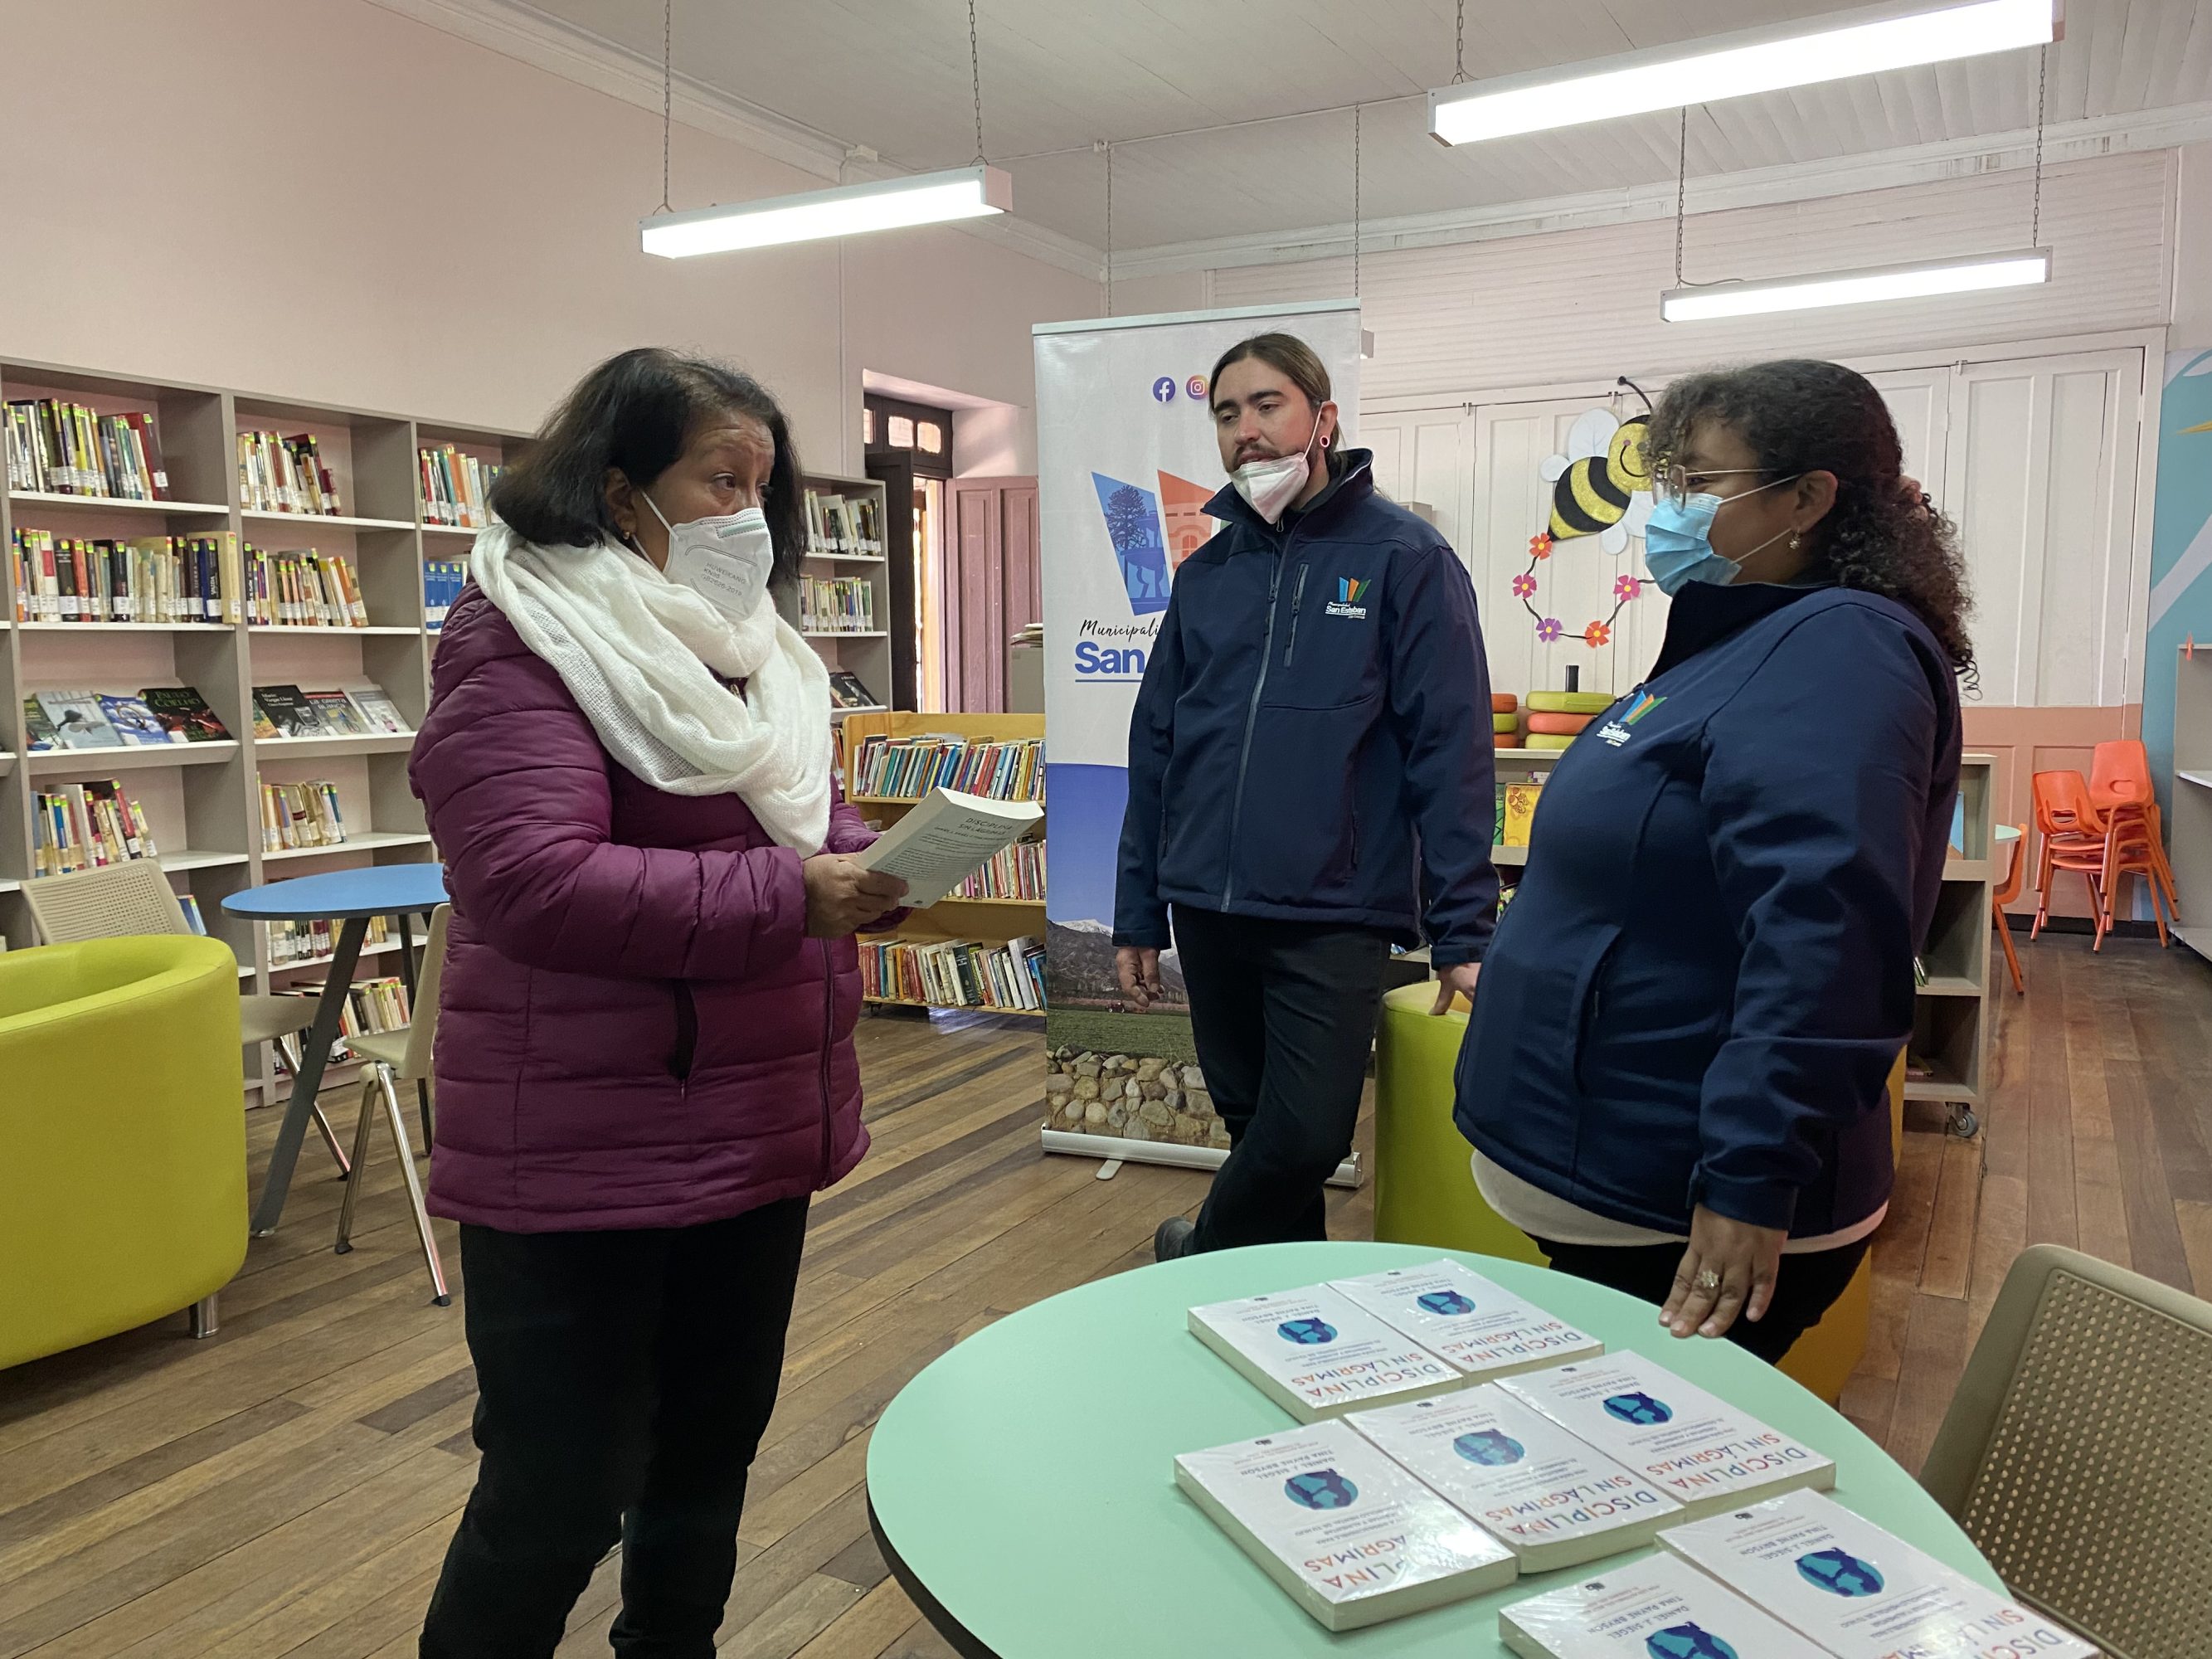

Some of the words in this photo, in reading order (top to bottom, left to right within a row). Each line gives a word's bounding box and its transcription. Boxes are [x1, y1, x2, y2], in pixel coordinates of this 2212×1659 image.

[1079, 618, 1159, 643] Municipali
[1075, 641, 1145, 674] San
[1459, 1331, 1583, 1364] DISCIPLINA
[1392, 1353, 1424, 1367] SIN
[1291, 1359, 1391, 1387] LÁGRIMAS
[1305, 1363, 1441, 1398] DISCIPLINA
[1746, 1433, 1782, 1450] SIN
[1646, 1440, 1747, 1477] LÁGRIMAS
[1668, 1447, 1807, 1490] DISCIPLINA
[1593, 1476, 1633, 1493] SIN
[1485, 1484, 1595, 1522] LÁGRIMAS
[1507, 1491, 1659, 1535] DISCIPLINA
[1626, 1604, 1660, 1619] PAYNE
[1659, 1596, 1684, 1607] TINA
[1587, 1616, 1628, 1634] BRYSON
[1653, 1605, 1690, 1622] DANIEL
[1981, 1609, 2025, 1631] SIN
[1607, 1623, 1644, 1640] SIEGEL
